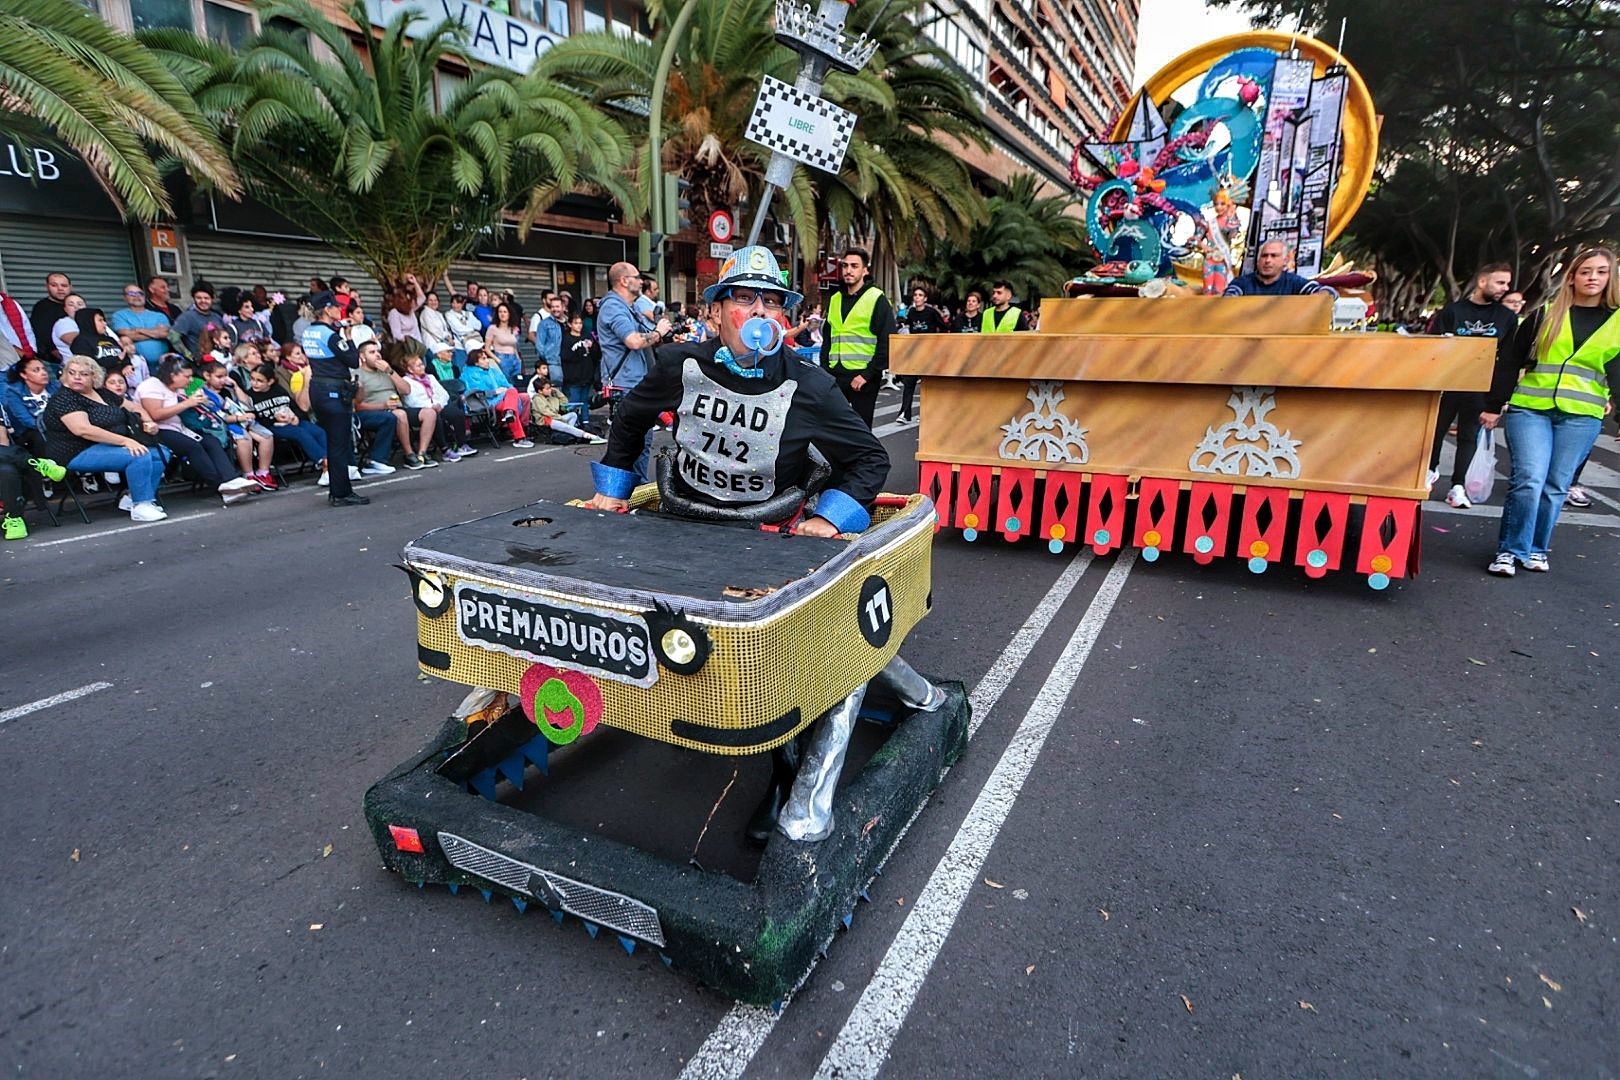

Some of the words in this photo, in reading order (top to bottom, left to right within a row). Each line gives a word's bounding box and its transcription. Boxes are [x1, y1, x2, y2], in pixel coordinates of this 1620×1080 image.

[788, 116, 816, 135] LIBRE
[157, 232, 170, 246] R
[692, 394, 769, 432] EDAD
[701, 431, 750, 463] 742
[683, 454, 764, 493] MESES
[865, 587, 890, 633] 17
[460, 599, 647, 666] PREMADUROS
